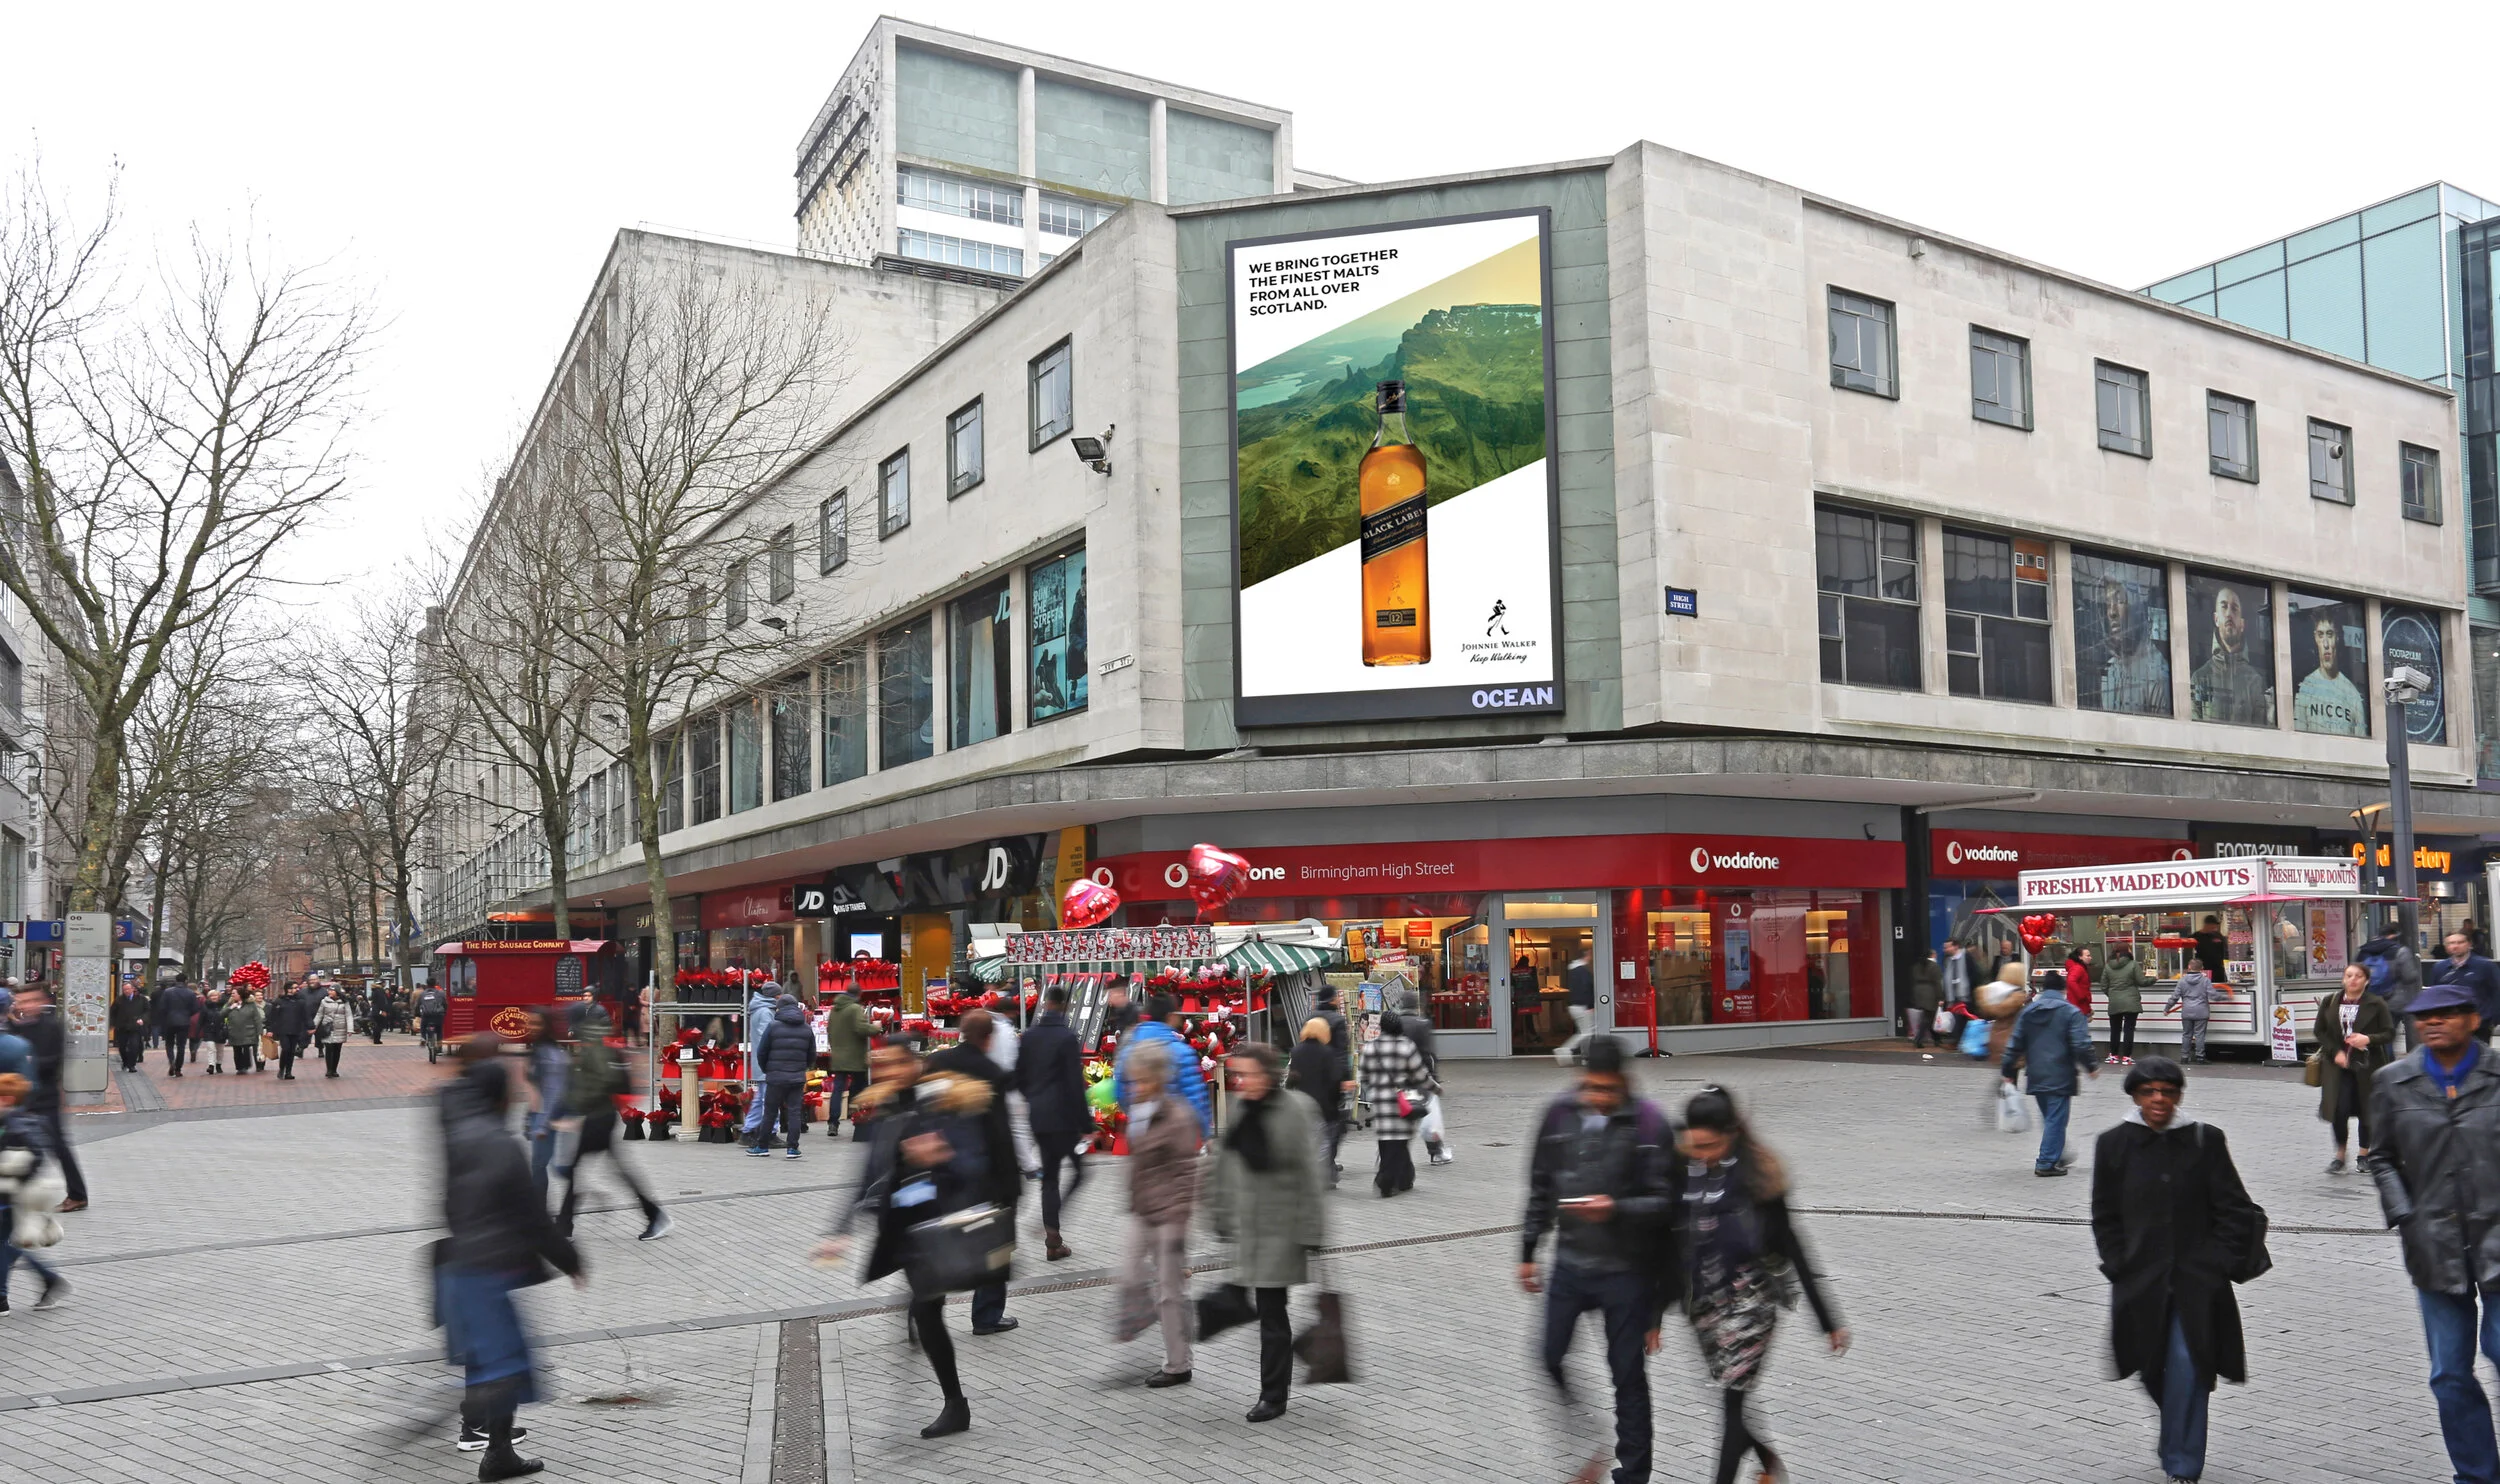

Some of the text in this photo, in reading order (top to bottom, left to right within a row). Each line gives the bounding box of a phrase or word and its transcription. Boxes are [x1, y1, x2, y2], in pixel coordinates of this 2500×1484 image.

[1249, 249, 1398, 274] WE BRING TOGETHER
[1249, 265, 1379, 288] THE FINEST MALTS
[1250, 281, 1360, 302] FROM ALL OVER
[1250, 299, 1327, 316] SCOTLAND.
[1363, 521, 1394, 539] BLACK
[1395, 508, 1425, 525] LABEL
[1033, 586, 1048, 601] RUN
[1673, 594, 1689, 603] HIGH
[1034, 600, 1047, 615] THE
[1670, 601, 1692, 610] STREET
[1034, 606, 1064, 629] STREETS
[1461, 640, 1537, 653] JOHNNIE WALKER
[1470, 652, 1527, 664] Keep Walking
[1472, 686, 1553, 708] OCEAN
[2310, 703, 2352, 722] NICCE
[1713, 851, 1780, 869] vodafone
[1965, 845, 2019, 862] vodafone
[2413, 846, 2452, 874] ctory
[981, 847, 1008, 891] JD
[1301, 864, 1378, 880] Birmingham
[1382, 863, 1412, 879] High
[1415, 862, 1455, 875] Street
[2267, 868, 2357, 884] FRESHLY MADE DONUTS
[2027, 868, 2250, 896] FRESHLY MADE DONUTS
[743, 896, 769, 918] Clintons
[798, 891, 825, 910] JD
[465, 940, 565, 949] THE HOT SAUSAGE COMPANY
[1389, 954, 1404, 962] SIGNS
[493, 1014, 505, 1025] HOT
[497, 1026, 526, 1036] COMPANY
[2272, 1033, 2295, 1042] Wedges
[2273, 1027, 2293, 1035] Potato
